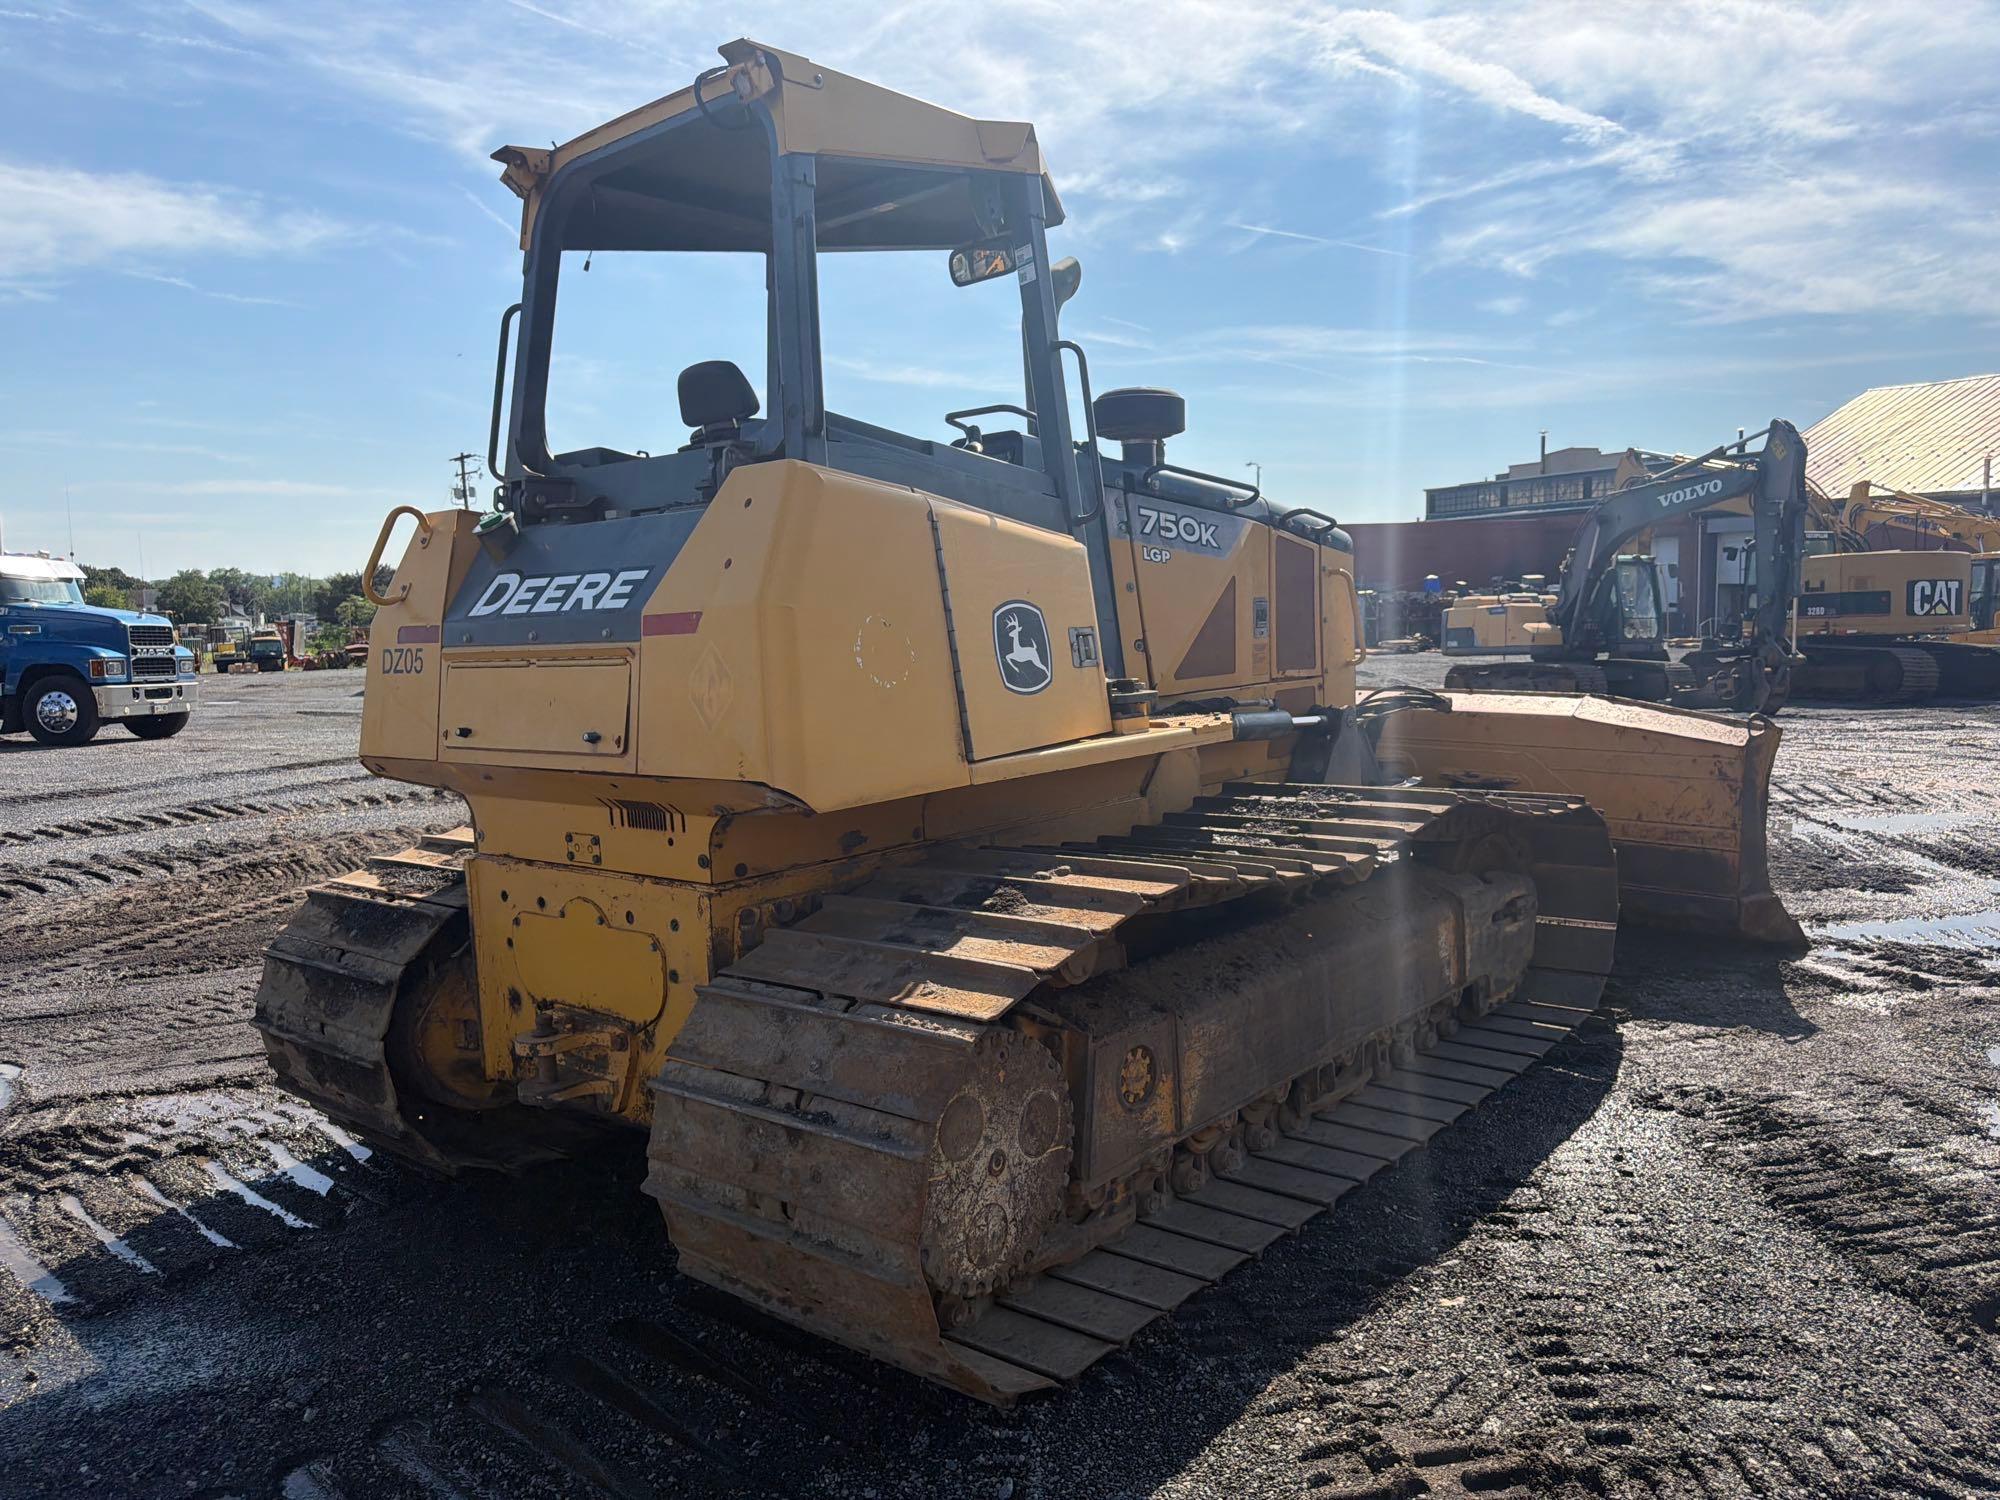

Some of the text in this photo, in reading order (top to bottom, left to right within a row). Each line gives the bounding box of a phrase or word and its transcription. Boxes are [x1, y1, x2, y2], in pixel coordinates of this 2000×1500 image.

[1657, 480, 1722, 507] VOLVO
[1139, 507, 1220, 549] 750K
[1143, 546, 1171, 563] LGP
[467, 569, 650, 617] DEERE
[1914, 580, 1959, 616] CAT
[382, 648, 424, 674] DZ05
